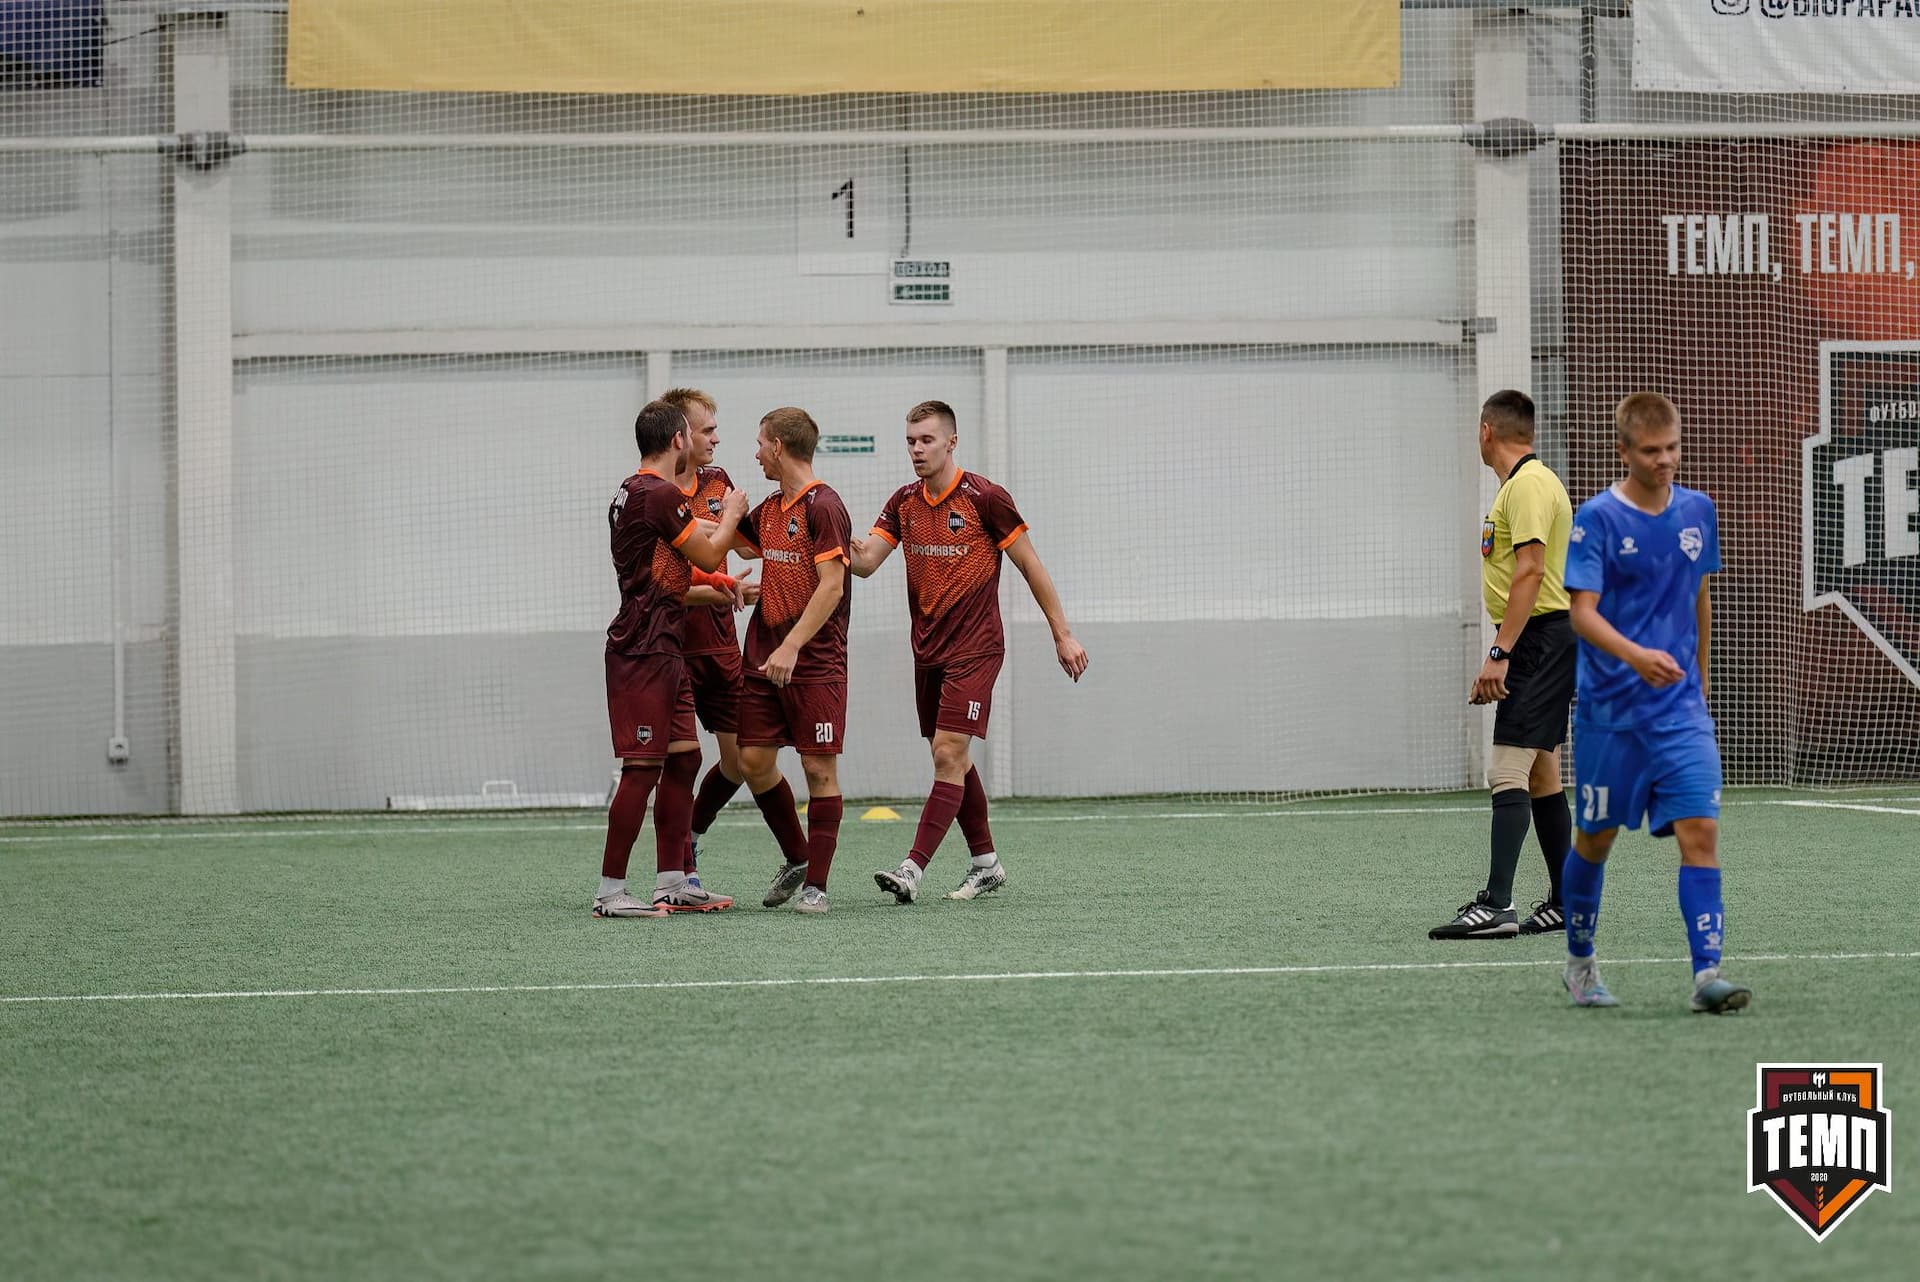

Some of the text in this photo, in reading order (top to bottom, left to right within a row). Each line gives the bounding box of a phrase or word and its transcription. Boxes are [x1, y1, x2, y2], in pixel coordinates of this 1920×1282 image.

[832, 177, 853, 238] 1
[1662, 213, 1914, 281] ТЕМП, ТЕМП,
[1870, 400, 1920, 423] ФУТБО
[1833, 446, 1920, 568] ТЕ
[967, 700, 981, 720] 15
[815, 722, 833, 743] 20
[1582, 784, 1609, 821] 21
[1571, 912, 1596, 927] 21
[1697, 912, 1722, 931] 21
